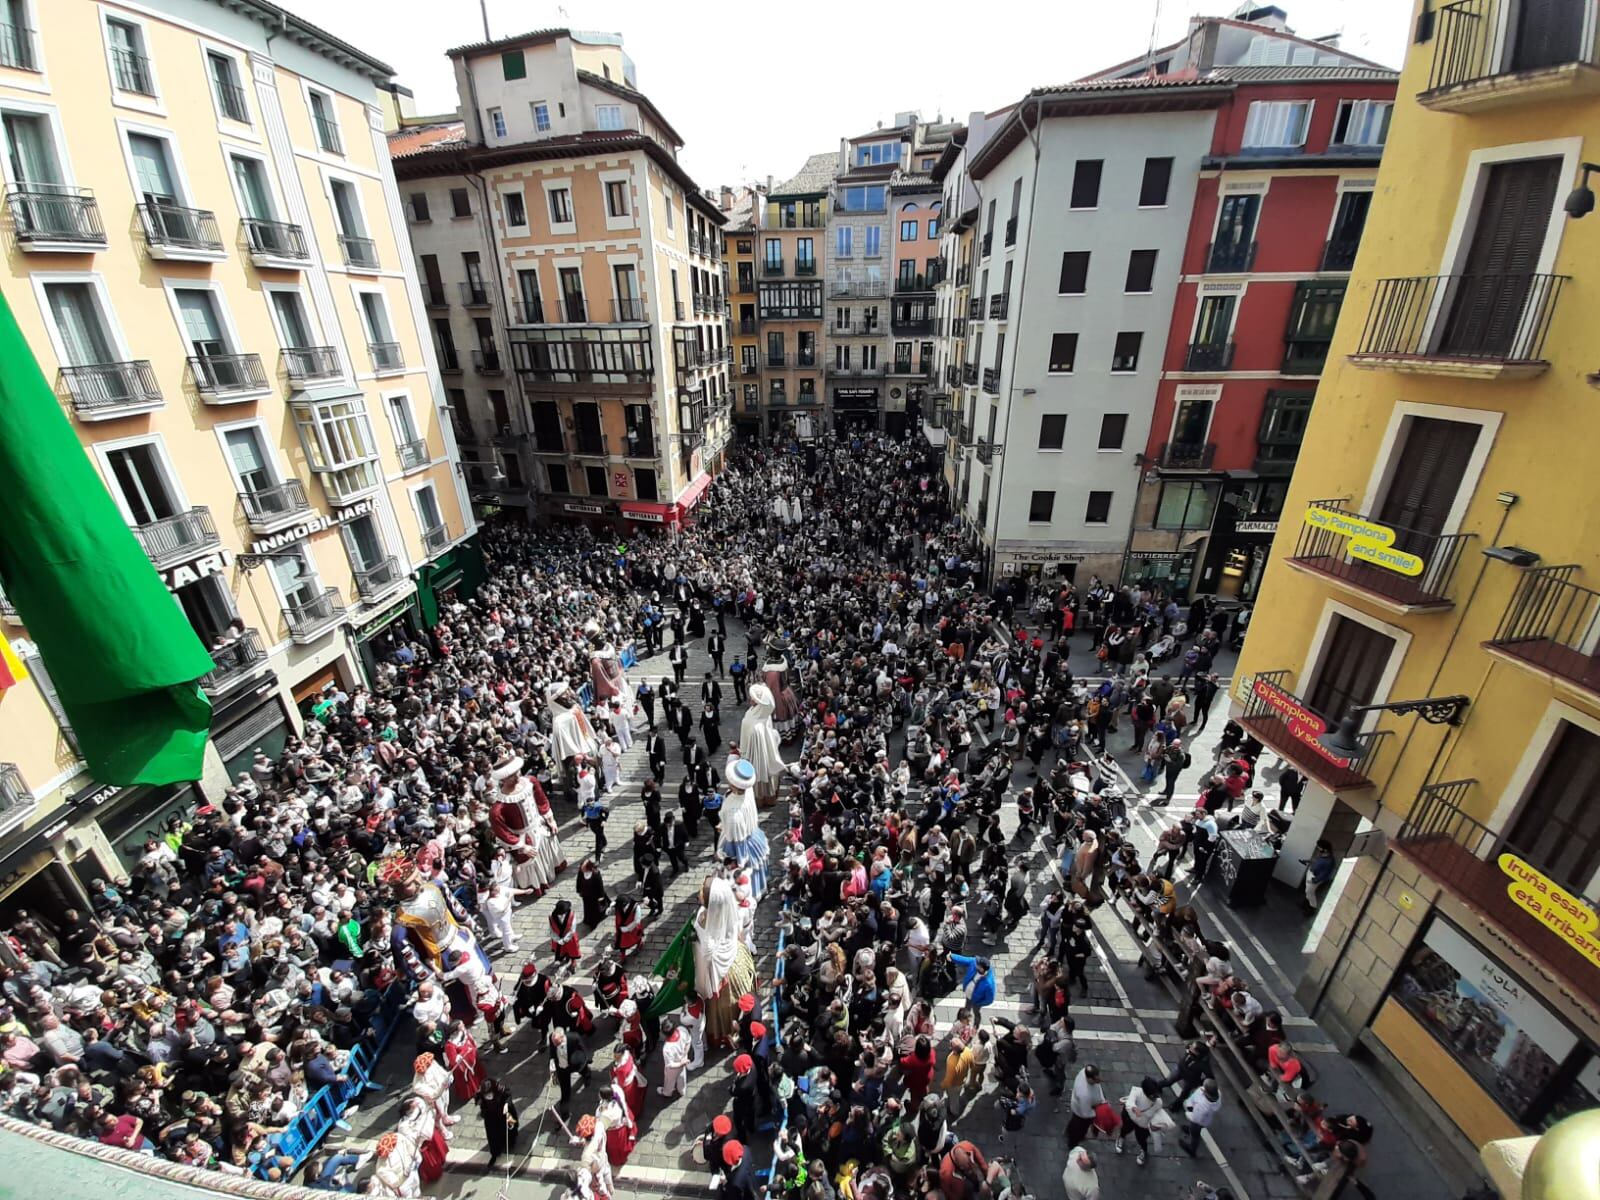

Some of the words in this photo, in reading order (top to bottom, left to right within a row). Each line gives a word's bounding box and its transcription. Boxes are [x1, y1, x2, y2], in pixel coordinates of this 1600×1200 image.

[252, 498, 381, 554] INMOBILIARIA
[1310, 510, 1328, 526] Say
[1330, 516, 1388, 542] Pamplona
[1012, 553, 1028, 561] The
[1031, 552, 1060, 561] Cookie
[1064, 554, 1085, 563] Shop
[1131, 552, 1180, 560] GUTIERREZ
[1353, 543, 1377, 557] and
[1378, 551, 1416, 570] smile!
[1259, 684, 1269, 697] Di
[1268, 693, 1320, 730] Pamplona
[1507, 859, 1548, 894] Iruña
[1550, 892, 1589, 924] esan
[1515, 889, 1543, 914] eta
